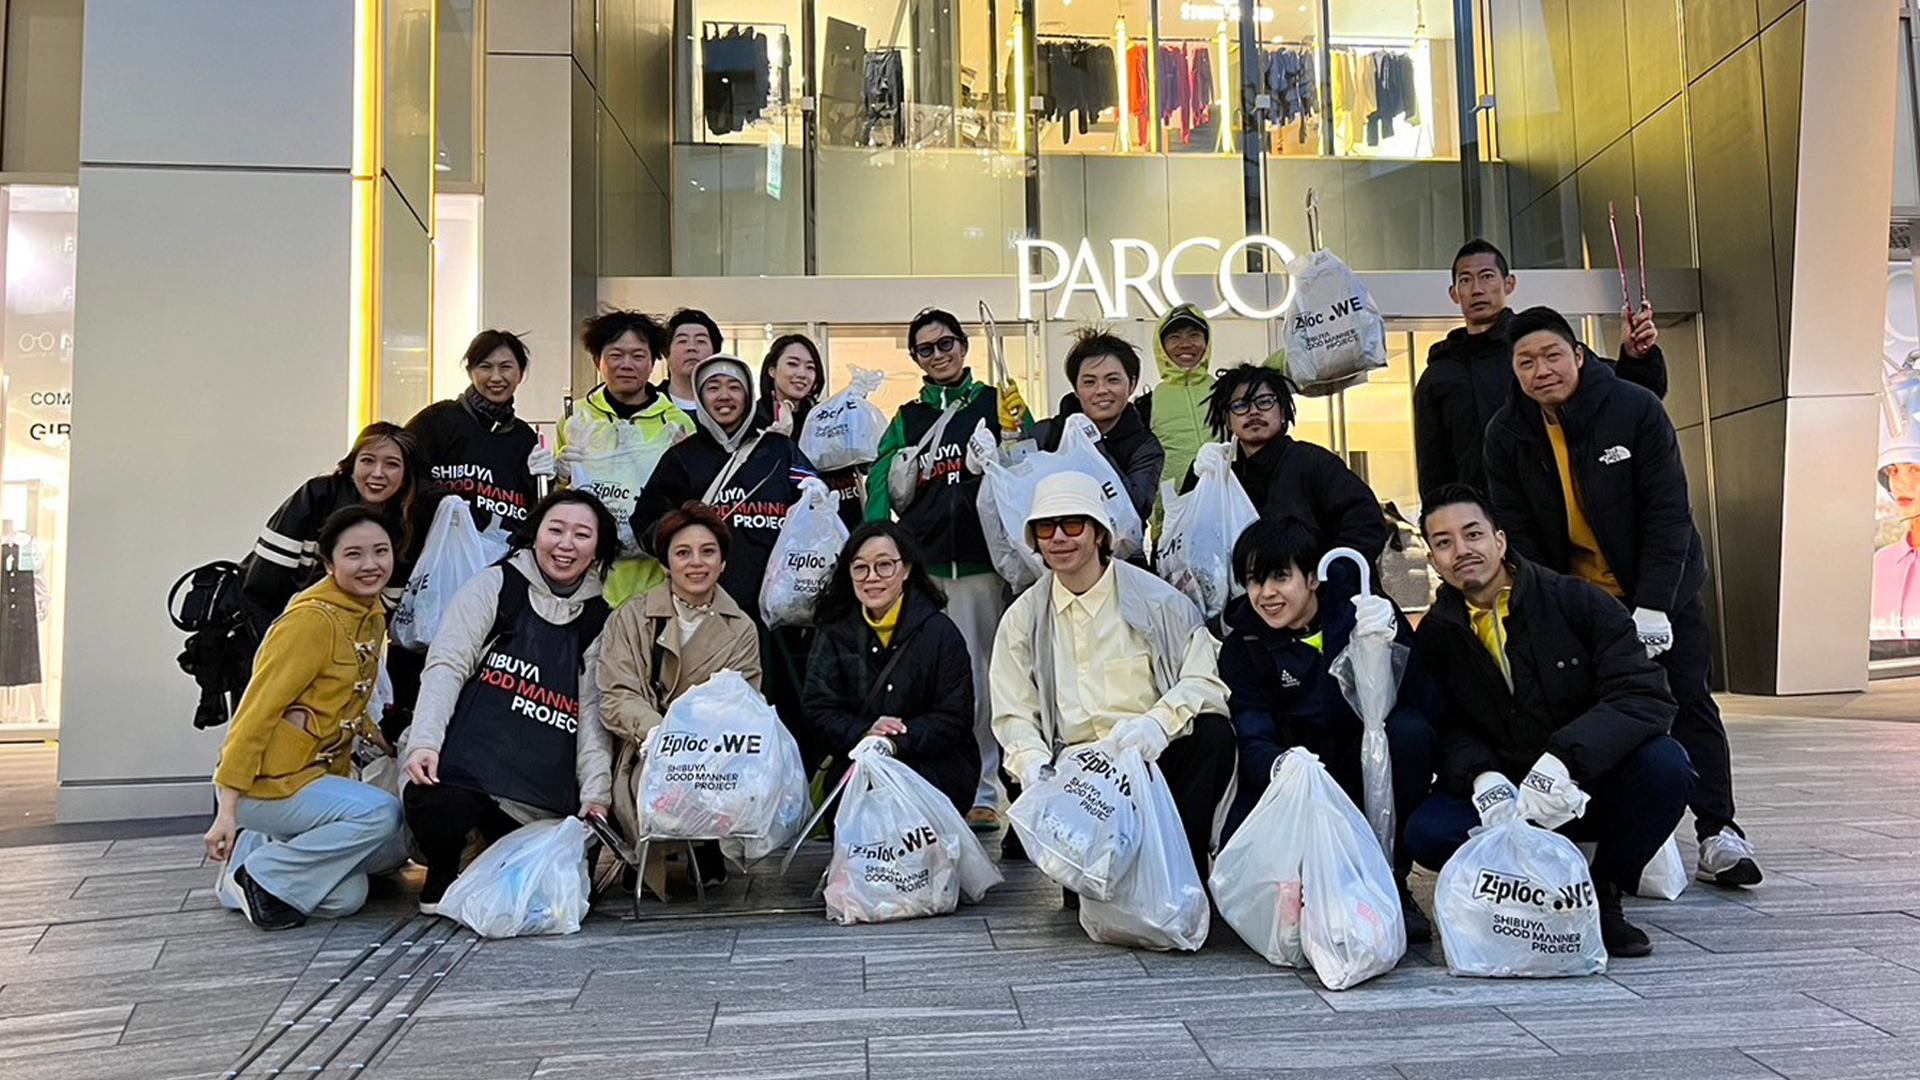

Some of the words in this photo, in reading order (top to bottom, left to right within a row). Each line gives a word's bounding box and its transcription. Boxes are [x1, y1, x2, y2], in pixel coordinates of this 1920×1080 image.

[1014, 233, 1298, 320] PARCO
[430, 463, 494, 484] SHIBUYA
[593, 482, 630, 500] Ziploc
[476, 494, 528, 521] PROJEC
[733, 513, 786, 530] PROJEC
[787, 552, 826, 572] Ziploc
[510, 694, 578, 734] PROJEC
[660, 734, 709, 757] Ziploc
[713, 734, 762, 754] .WE
[665, 772, 695, 782] GOOD
[695, 772, 740, 782] MANNER
[667, 763, 706, 773] SHIBUYA
[694, 781, 738, 791] PROJECT
[1480, 872, 1546, 906] Ziploc
[1492, 913, 1546, 932] SHIBUYA
[1492, 924, 1531, 939] GOOD
[1531, 931, 1582, 944] MANNER
[1530, 941, 1582, 955] PROJECT
